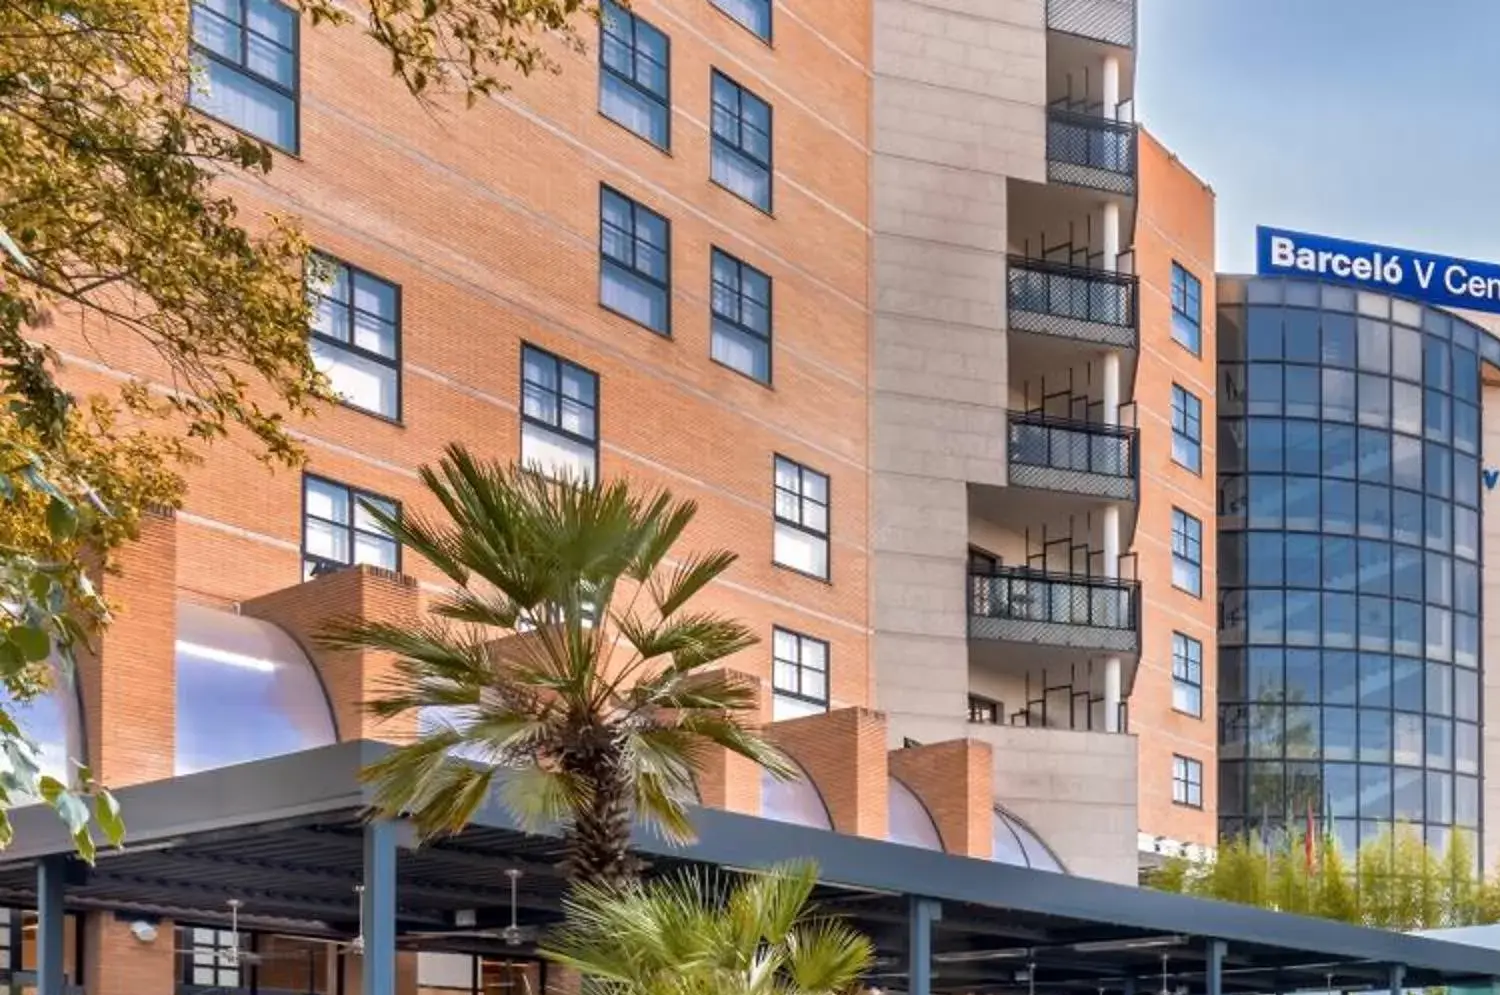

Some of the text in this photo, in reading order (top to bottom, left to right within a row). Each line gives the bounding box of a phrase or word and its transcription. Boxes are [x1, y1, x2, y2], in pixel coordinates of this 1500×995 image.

[1270, 235, 1402, 284] Barceló
[1413, 260, 1436, 290] V
[1482, 469, 1500, 490] V
